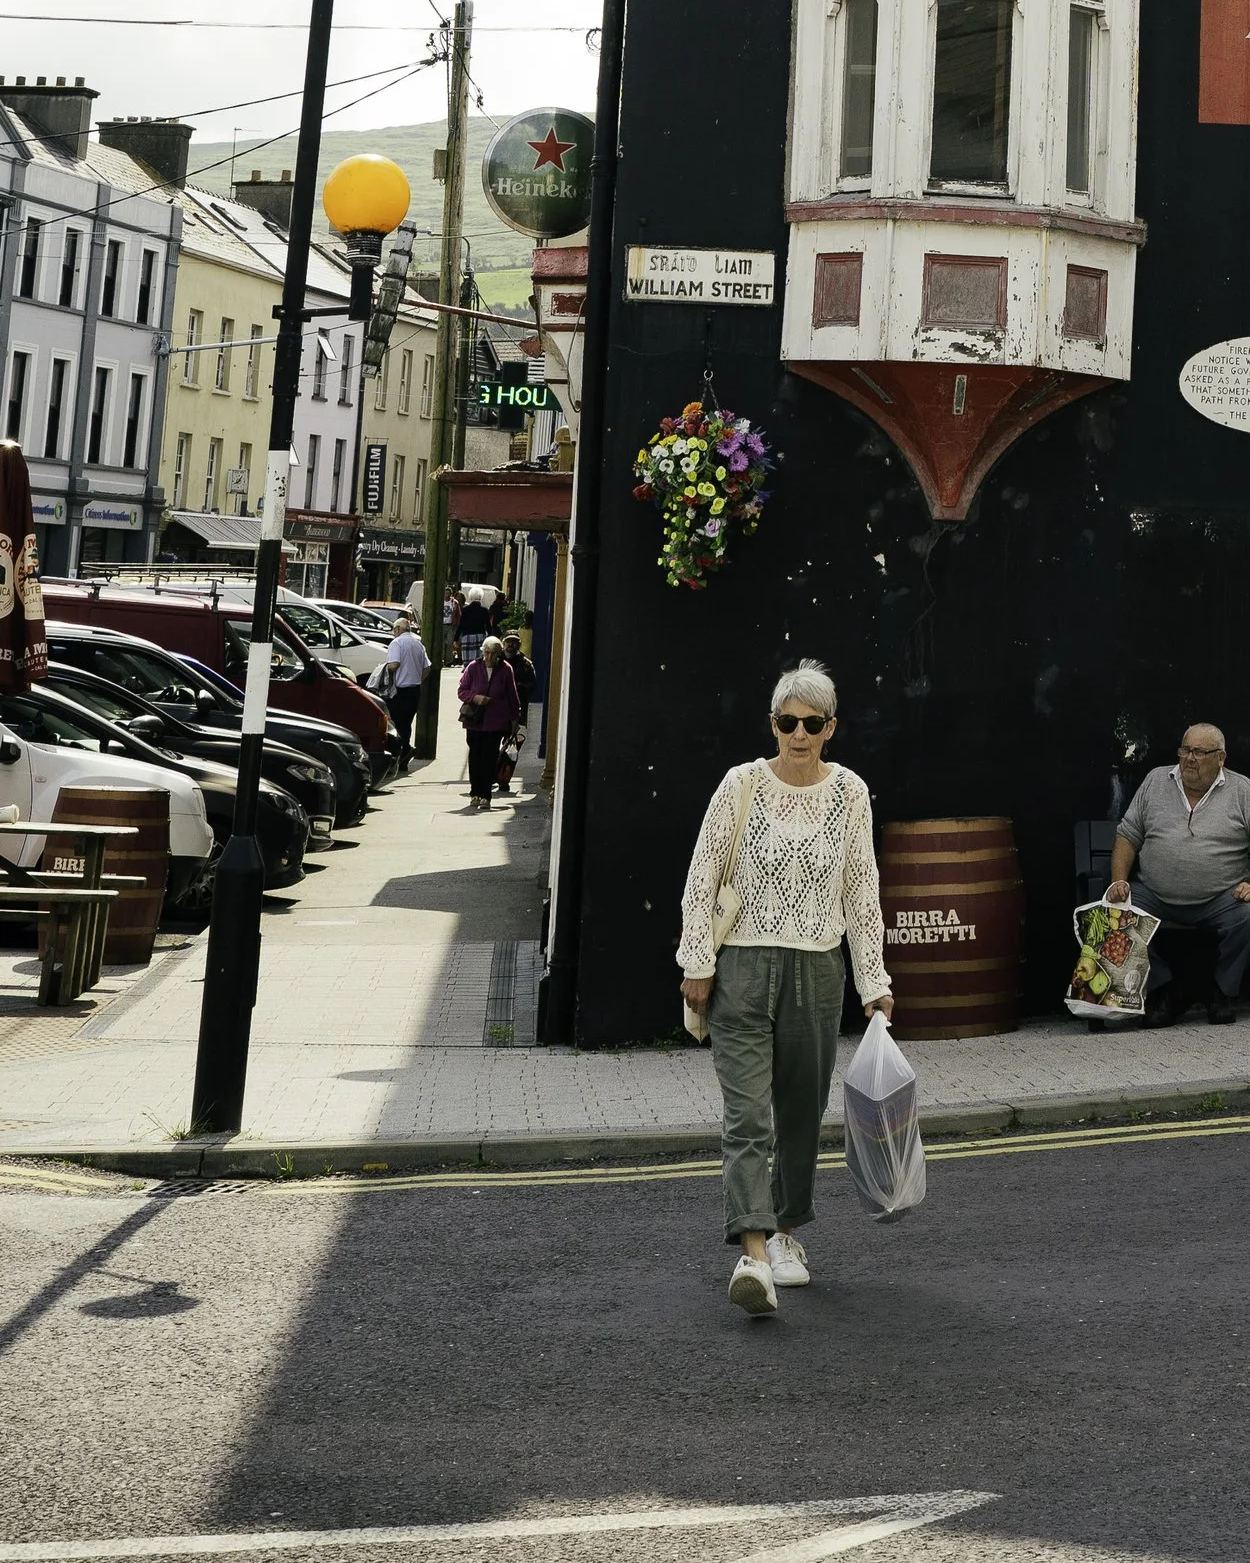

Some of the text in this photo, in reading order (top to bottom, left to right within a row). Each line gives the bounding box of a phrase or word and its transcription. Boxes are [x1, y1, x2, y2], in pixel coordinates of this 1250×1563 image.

[496, 177, 593, 199] Heinek
[629, 278, 773, 300] WILLIAM STREET
[1208, 356, 1240, 366] NOTICE
[1192, 364, 1225, 374] FUTURE
[1184, 375, 1213, 384] ASKED
[1218, 377, 1230, 385] AS
[1234, 377, 1241, 385] A
[1191, 385, 1212, 394] THAT
[1200, 396, 1223, 405] PATH
[1229, 411, 1247, 420] THE
[54, 857, 85, 872] BIR
[896, 909, 960, 928] BIRRA
[887, 925, 977, 945] MORETTI
